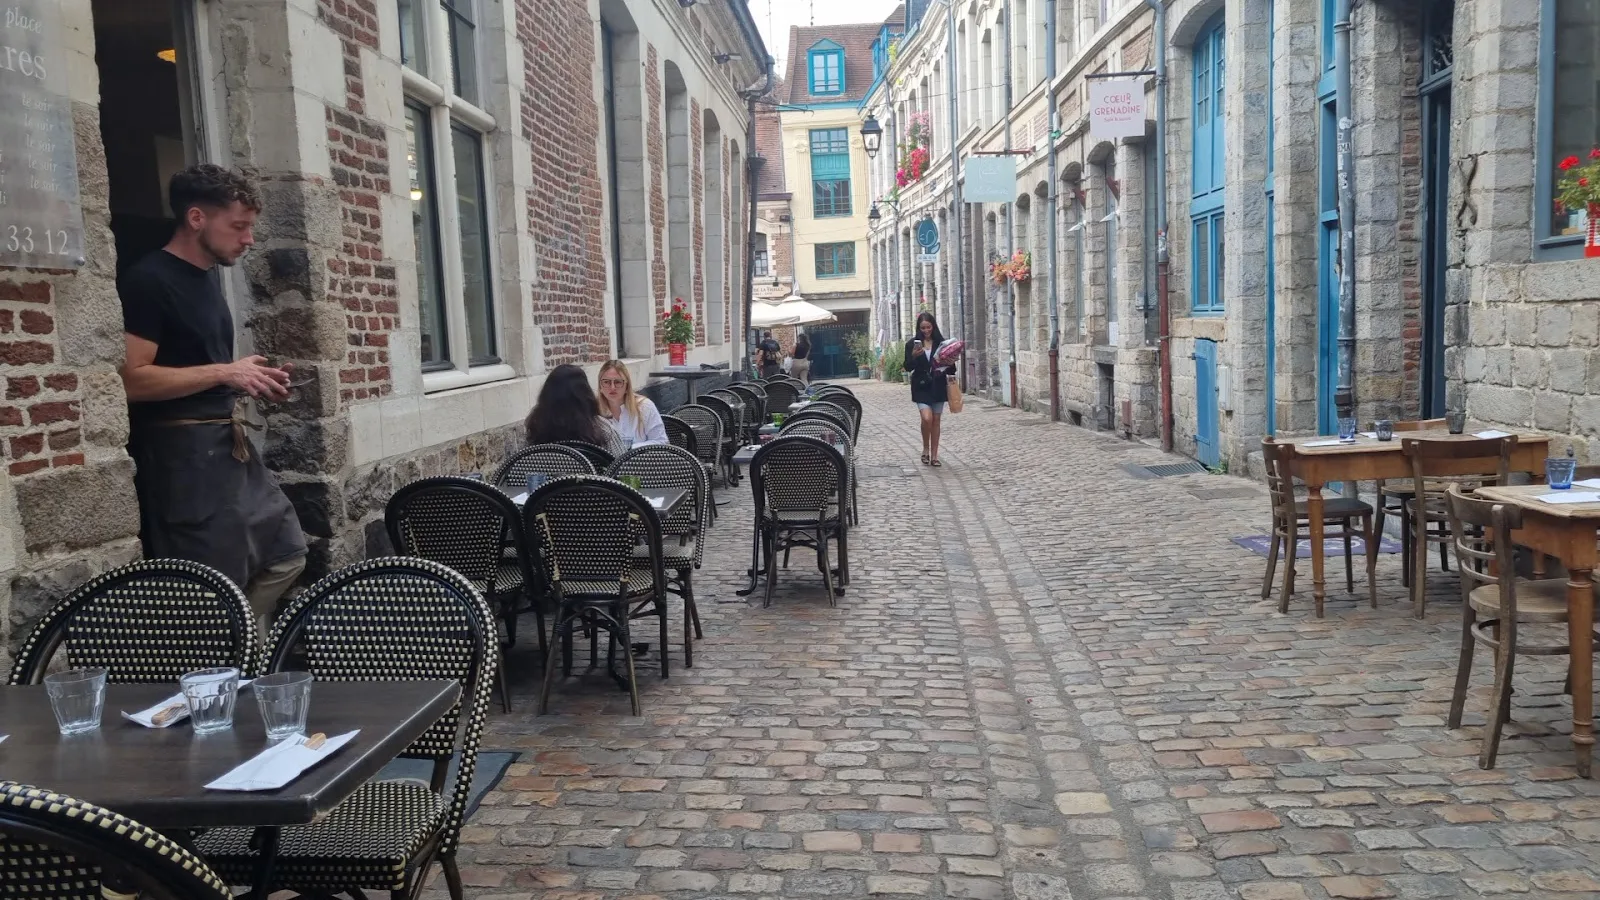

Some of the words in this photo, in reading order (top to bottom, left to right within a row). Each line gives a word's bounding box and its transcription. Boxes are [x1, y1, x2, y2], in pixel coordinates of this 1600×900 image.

[5, 7, 41, 34] place
[0, 46, 46, 80] res
[1094, 105, 1141, 116] GRENADINE
[7, 225, 34, 253] 33
[45, 229, 69, 255] 12
